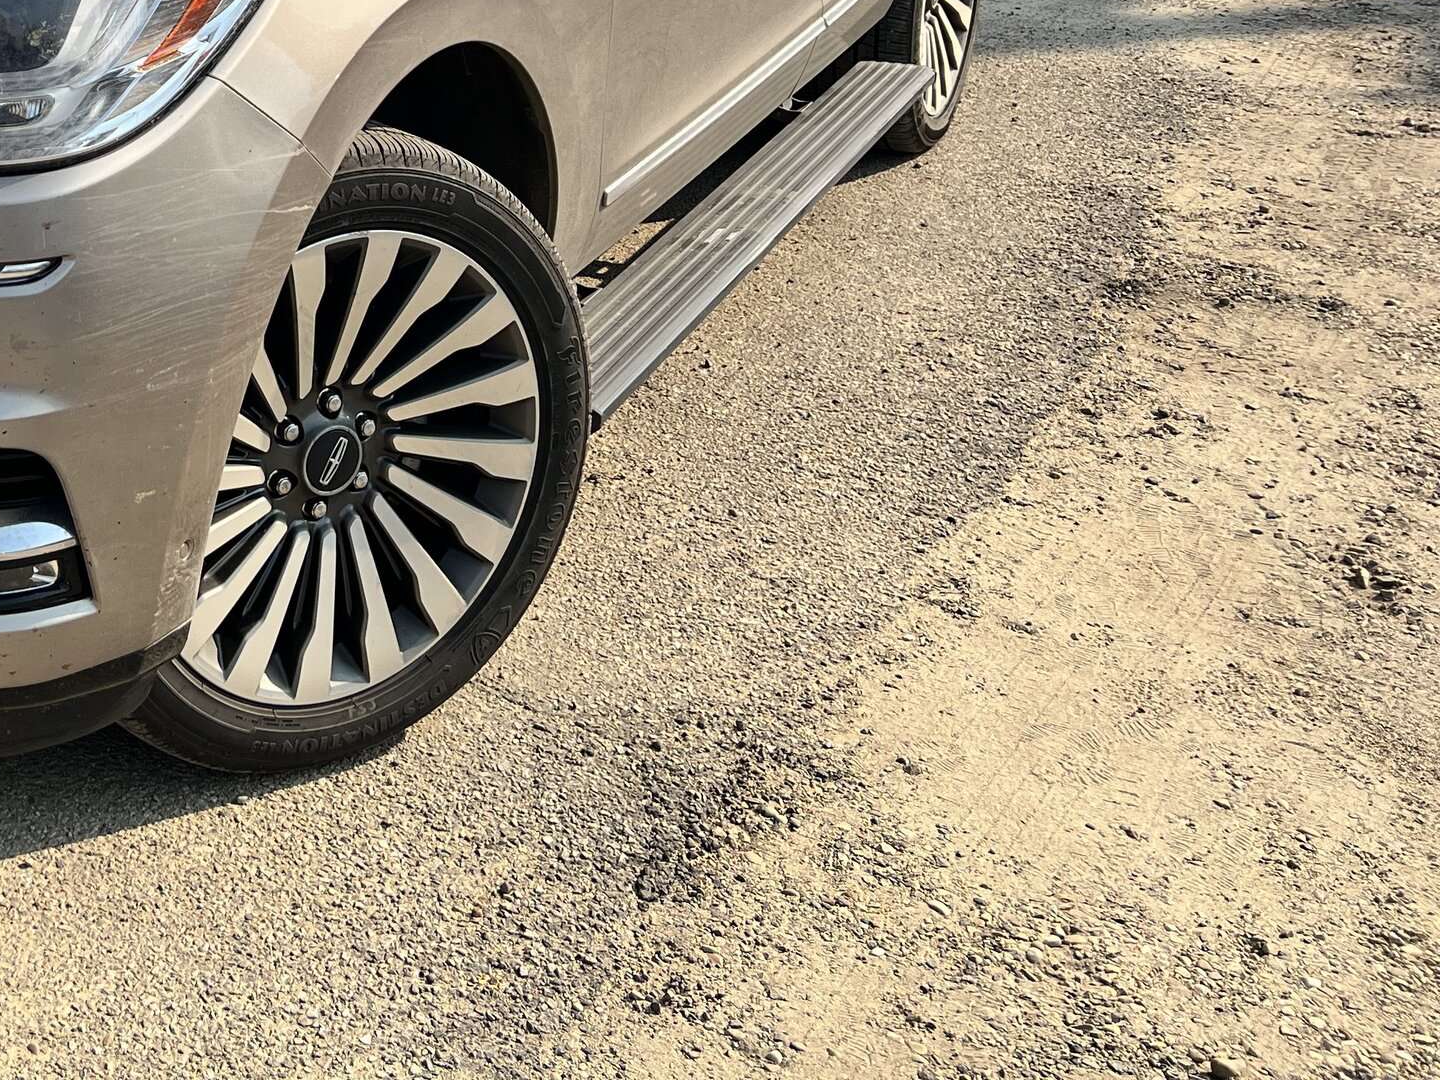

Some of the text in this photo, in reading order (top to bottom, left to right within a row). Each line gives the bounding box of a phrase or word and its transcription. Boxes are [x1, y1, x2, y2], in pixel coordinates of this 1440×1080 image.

[431, 187, 456, 206] LE3
[516, 335, 583, 595] Firestone
[280, 678, 448, 754] DESTINATION
